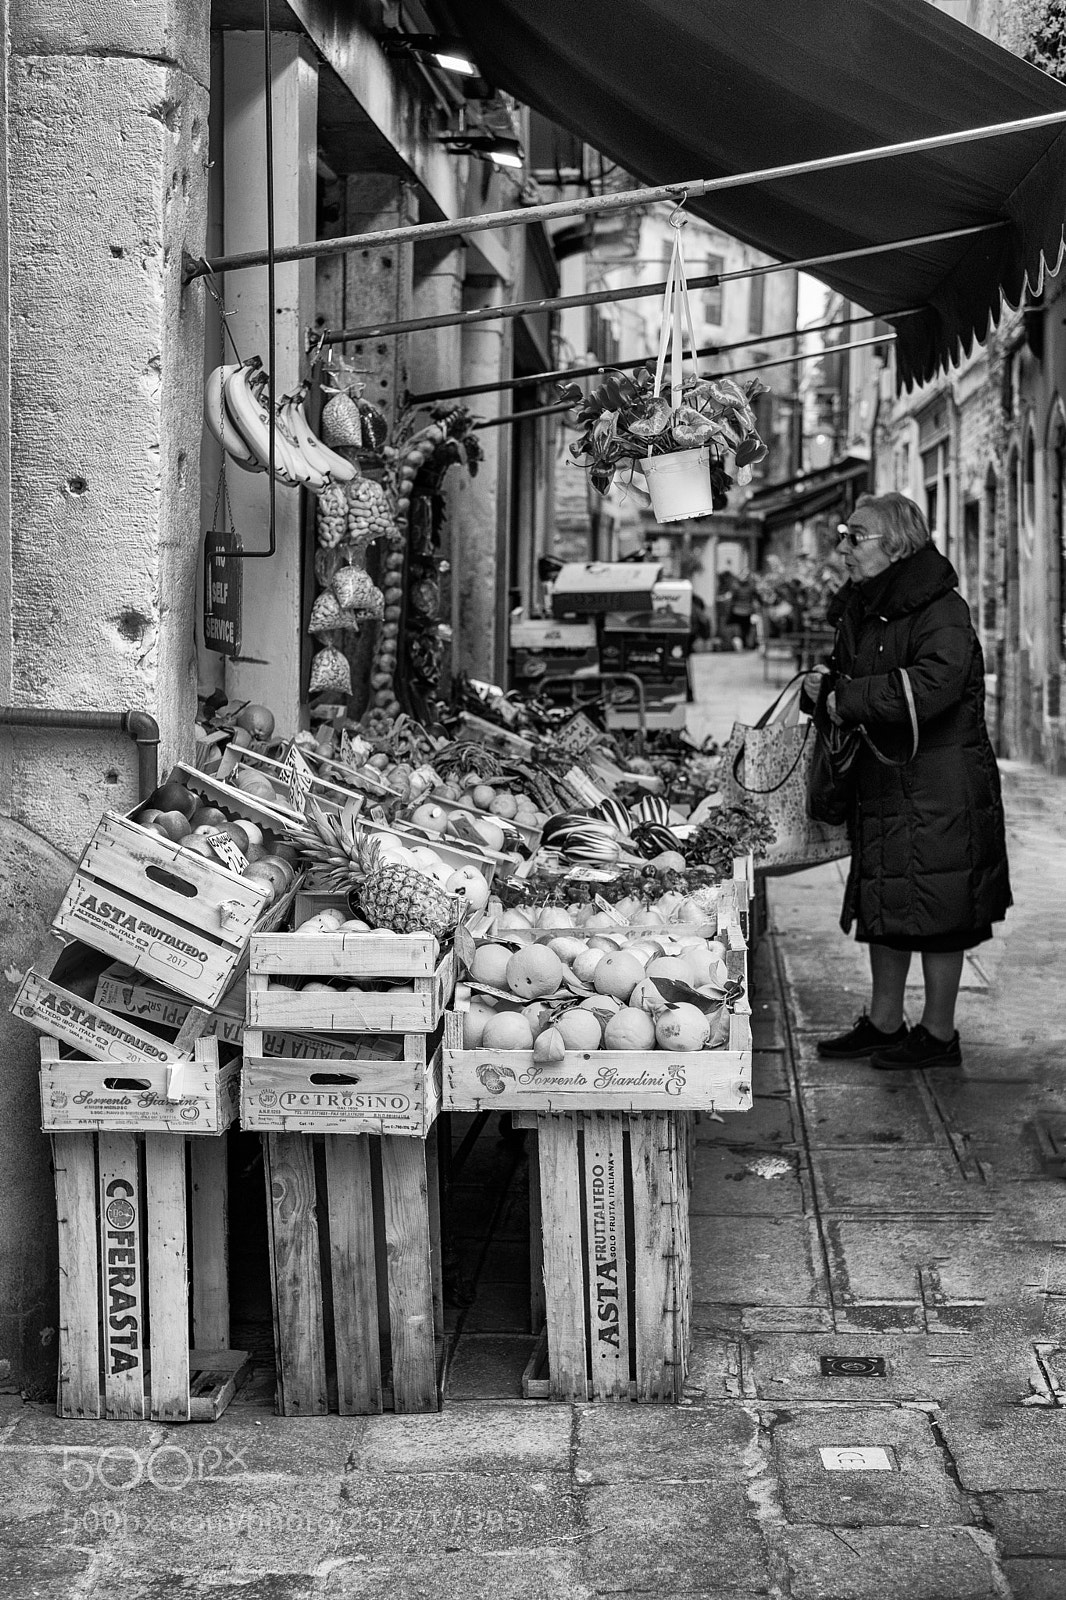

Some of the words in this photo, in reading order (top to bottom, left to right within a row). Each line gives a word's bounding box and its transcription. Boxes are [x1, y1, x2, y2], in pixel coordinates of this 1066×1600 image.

[212, 581, 229, 604] SELF
[206, 617, 234, 643] SERVICE
[80, 895, 137, 933] ASTA
[137, 920, 209, 963] FRUTTALTEDO
[118, 928, 136, 941] ITALY
[166, 953, 188, 968] 2017
[36, 1005, 62, 1022] ALTEDO
[78, 1027, 97, 1039] ITALY
[40, 993, 97, 1032] ASTA
[96, 1020, 168, 1062] FRUTTALTEDO
[518, 1067, 587, 1086] Sorrento
[593, 1067, 665, 1089] Giardini
[72, 1090, 132, 1105] Sorrento
[607, 1160, 615, 1198] ITALIANA
[592, 1164, 607, 1261] FRUTTALTEDO
[608, 1200, 616, 1232] FRUTTA
[609, 1235, 617, 1258] SOLO
[596, 1258, 620, 1349] ASTA
